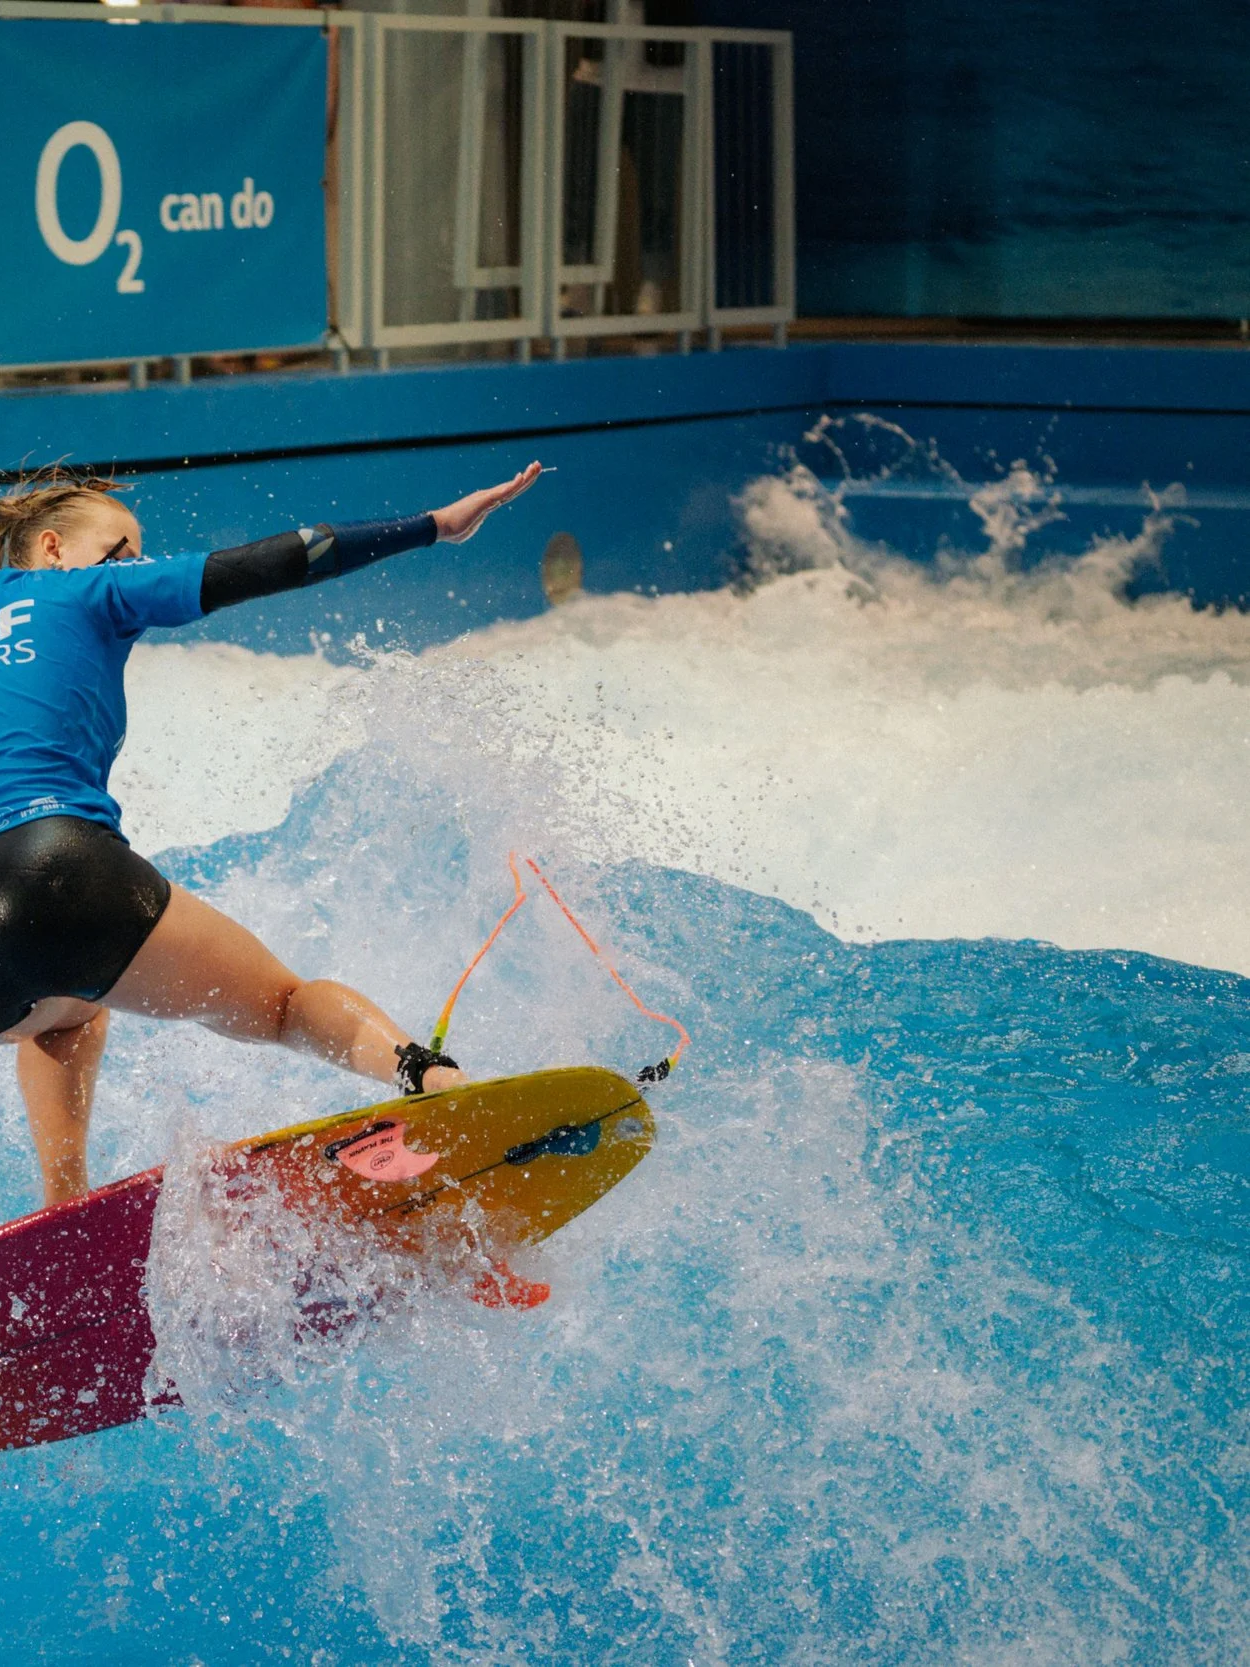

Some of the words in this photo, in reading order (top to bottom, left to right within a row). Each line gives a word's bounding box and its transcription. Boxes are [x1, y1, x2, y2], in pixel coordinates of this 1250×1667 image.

[35, 120, 145, 294] O2
[159, 192, 224, 232] can
[230, 176, 274, 229] do
[380, 1135, 393, 1145] THE
